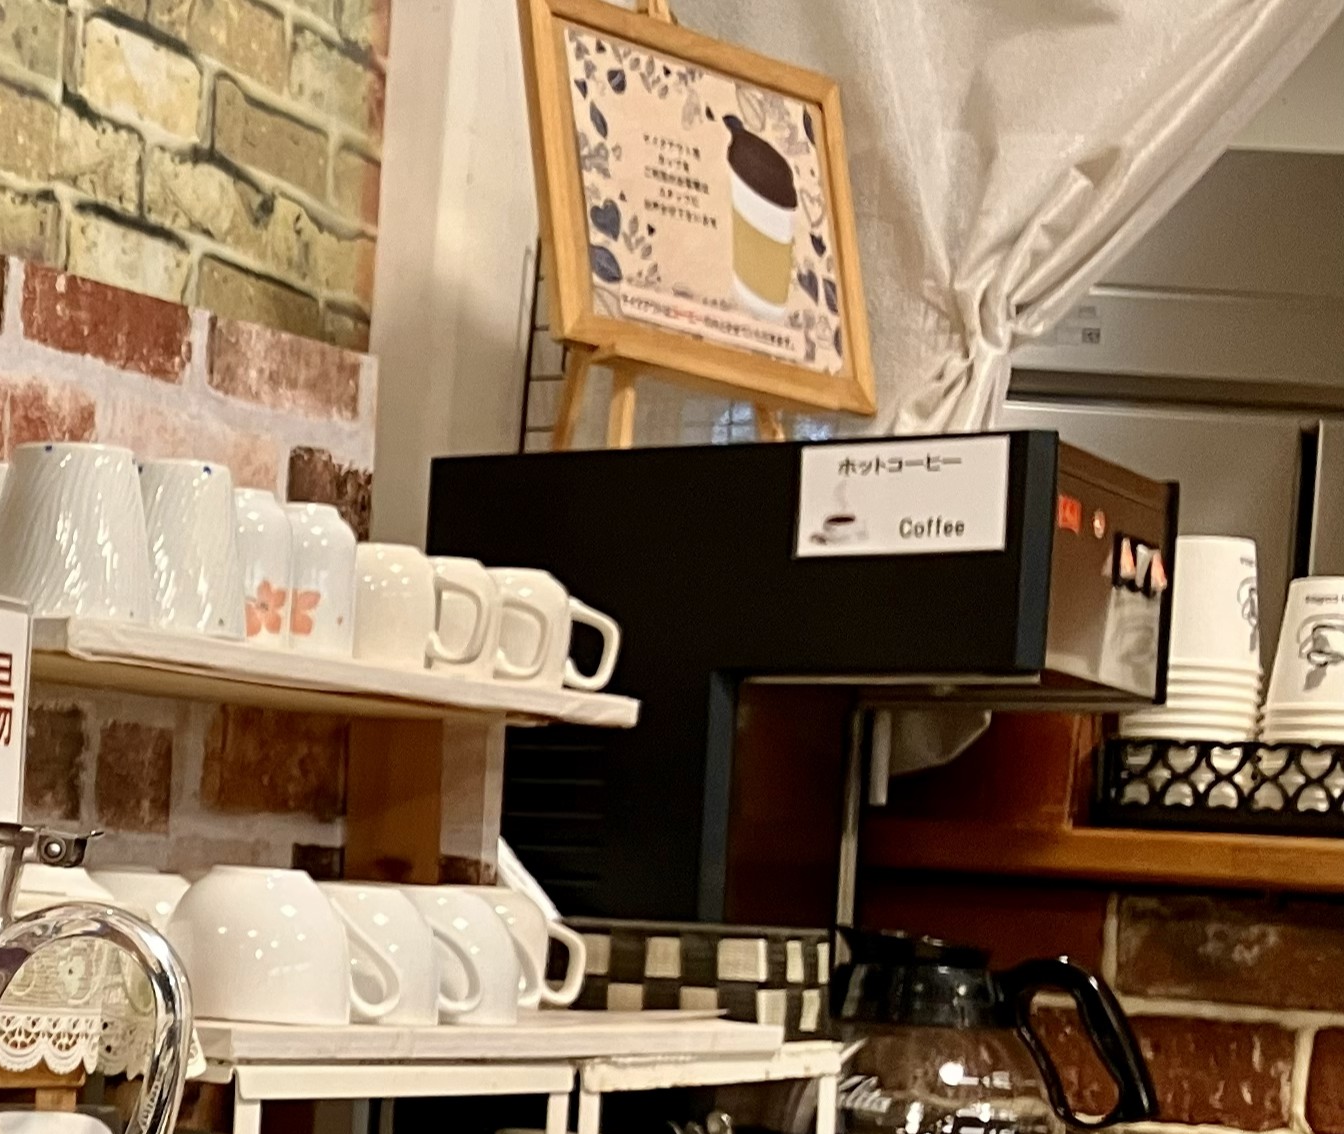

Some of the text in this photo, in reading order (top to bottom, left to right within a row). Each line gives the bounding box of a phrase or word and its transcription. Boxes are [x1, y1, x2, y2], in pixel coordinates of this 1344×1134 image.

[837, 453, 962, 477] ホットコーヒー
[898, 514, 965, 539] Coffee
